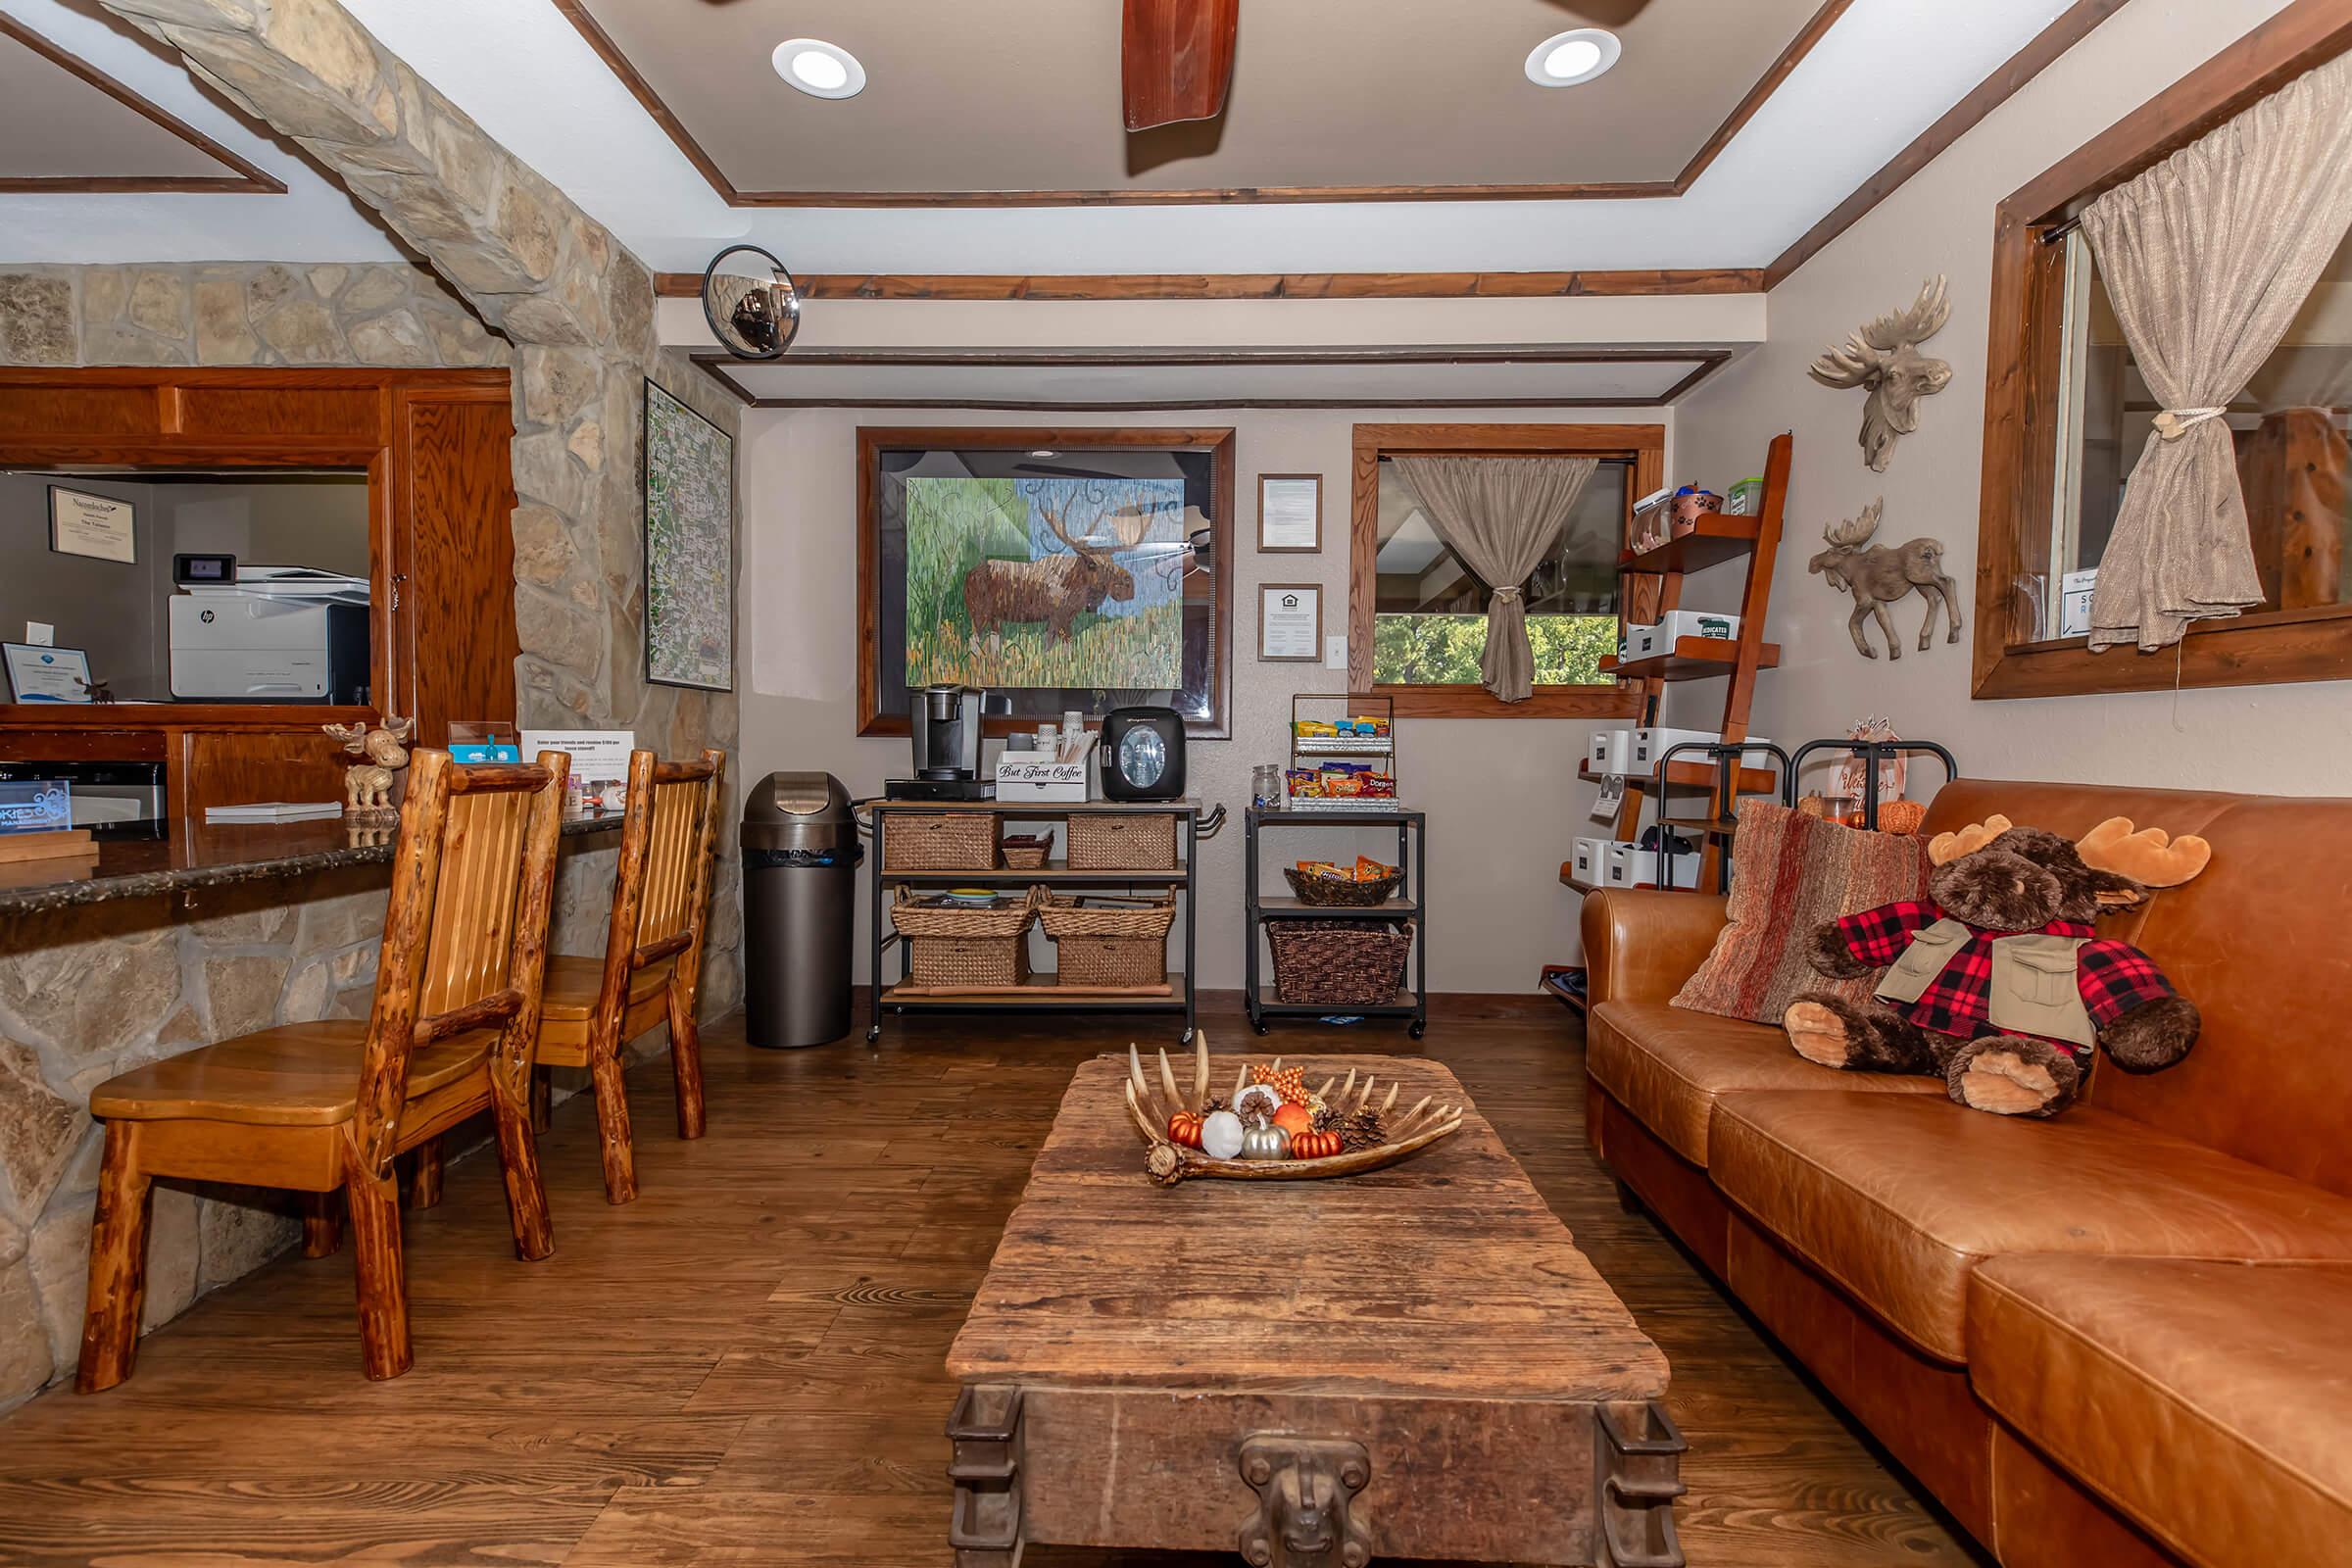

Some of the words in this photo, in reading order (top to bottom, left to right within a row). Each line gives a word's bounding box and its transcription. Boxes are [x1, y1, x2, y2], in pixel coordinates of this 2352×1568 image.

[201, 610, 215, 623] hp
[999, 763, 1022, 778] But
[1023, 765, 1052, 779] First
[1053, 765, 1083, 781] Coffee
